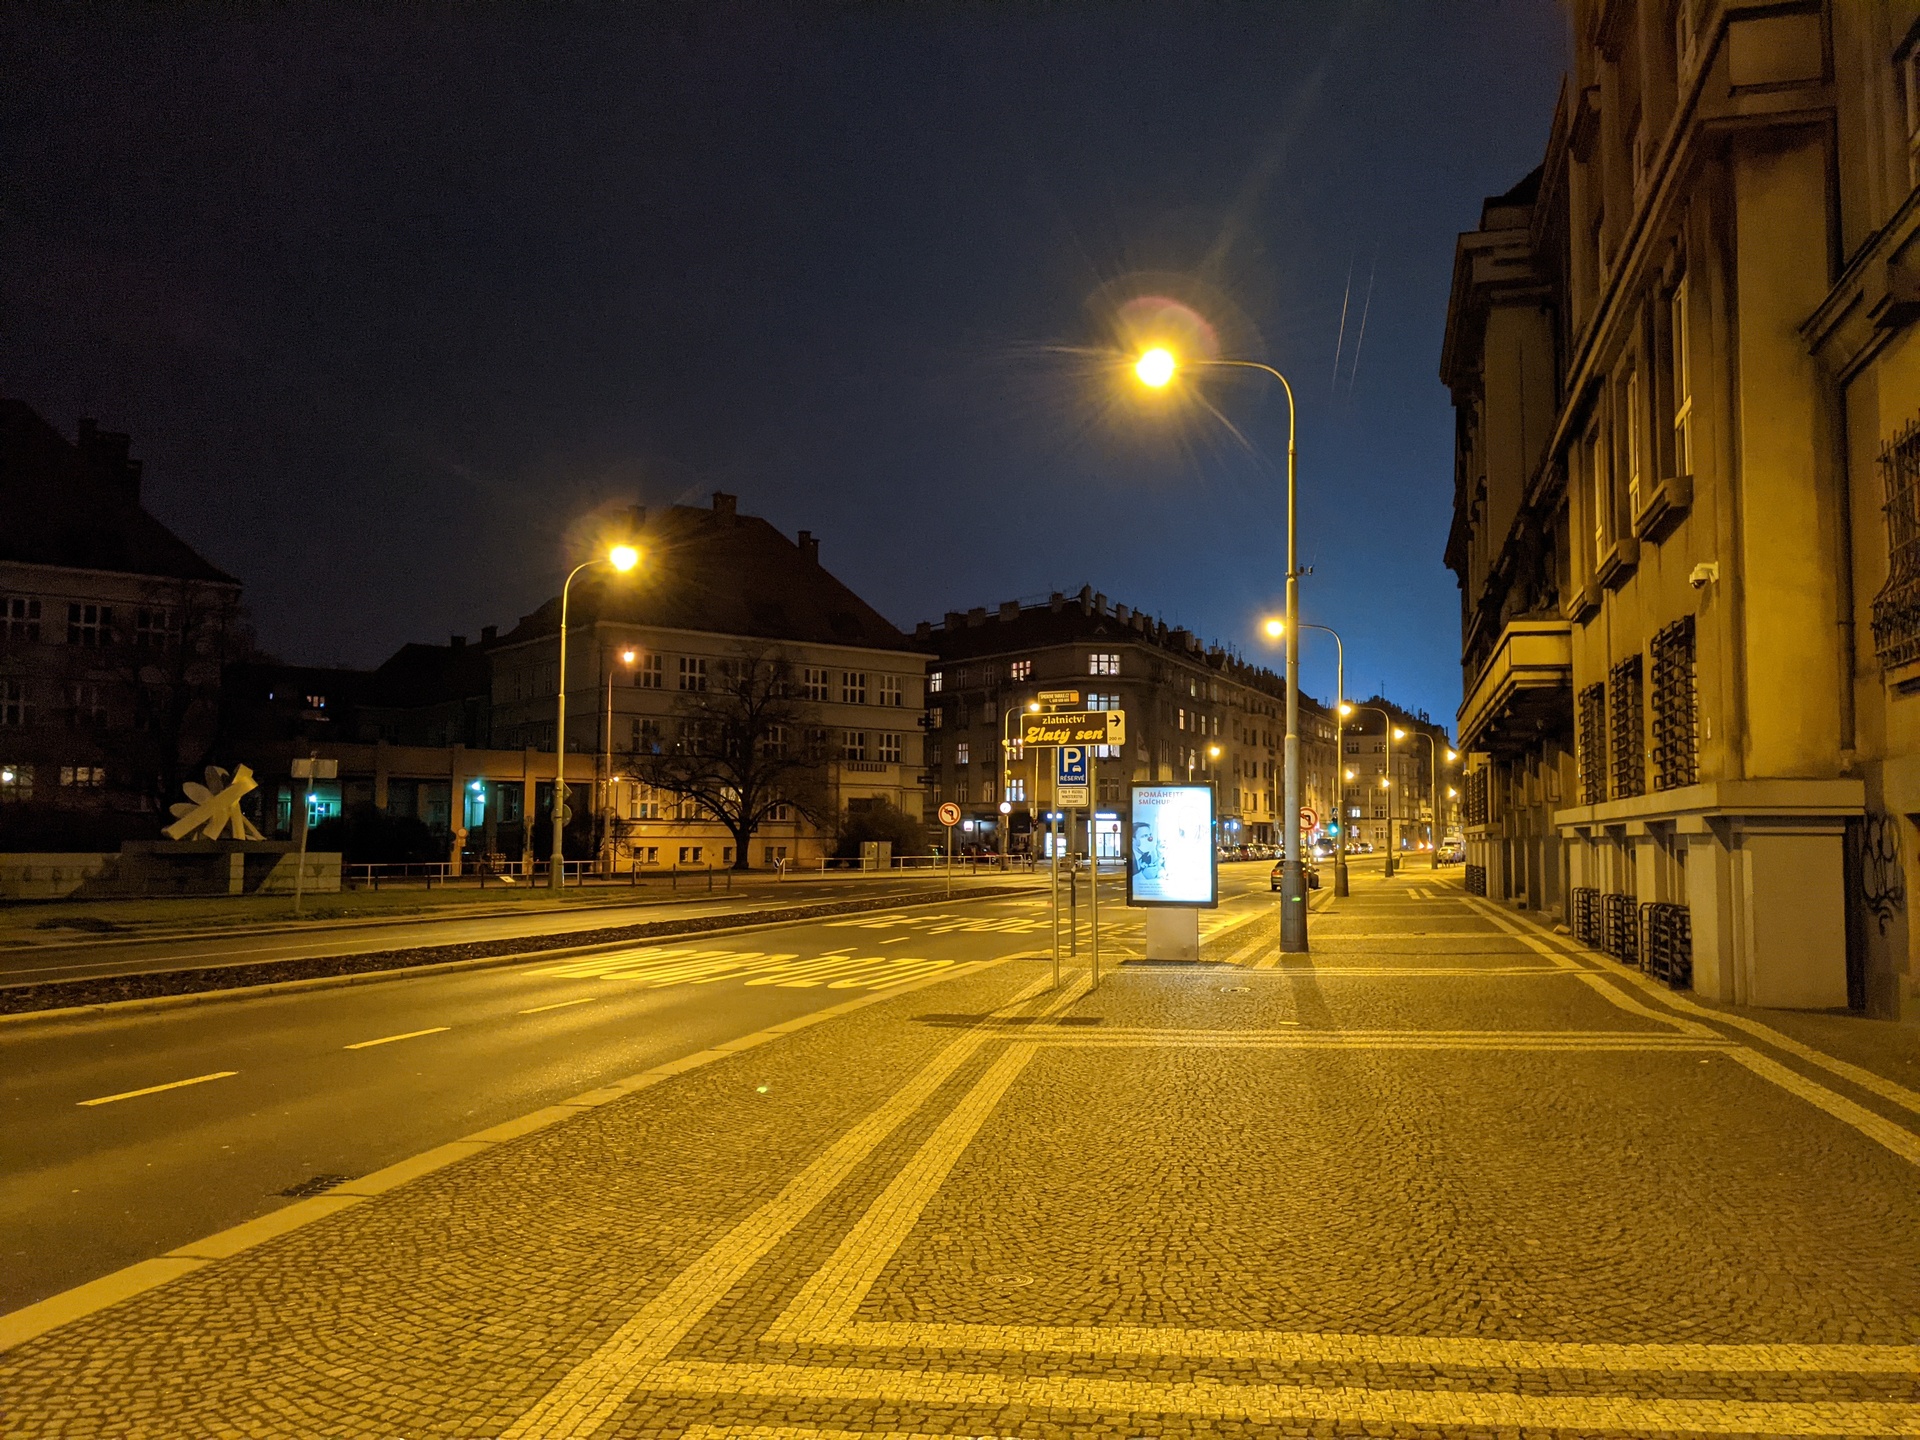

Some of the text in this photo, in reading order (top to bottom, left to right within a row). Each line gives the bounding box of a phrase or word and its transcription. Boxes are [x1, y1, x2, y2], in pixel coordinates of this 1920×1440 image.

[1042, 714, 1086, 725] zlatnictví
[1025, 726, 1070, 744] Zlatý
[1063, 748, 1081, 773] P
